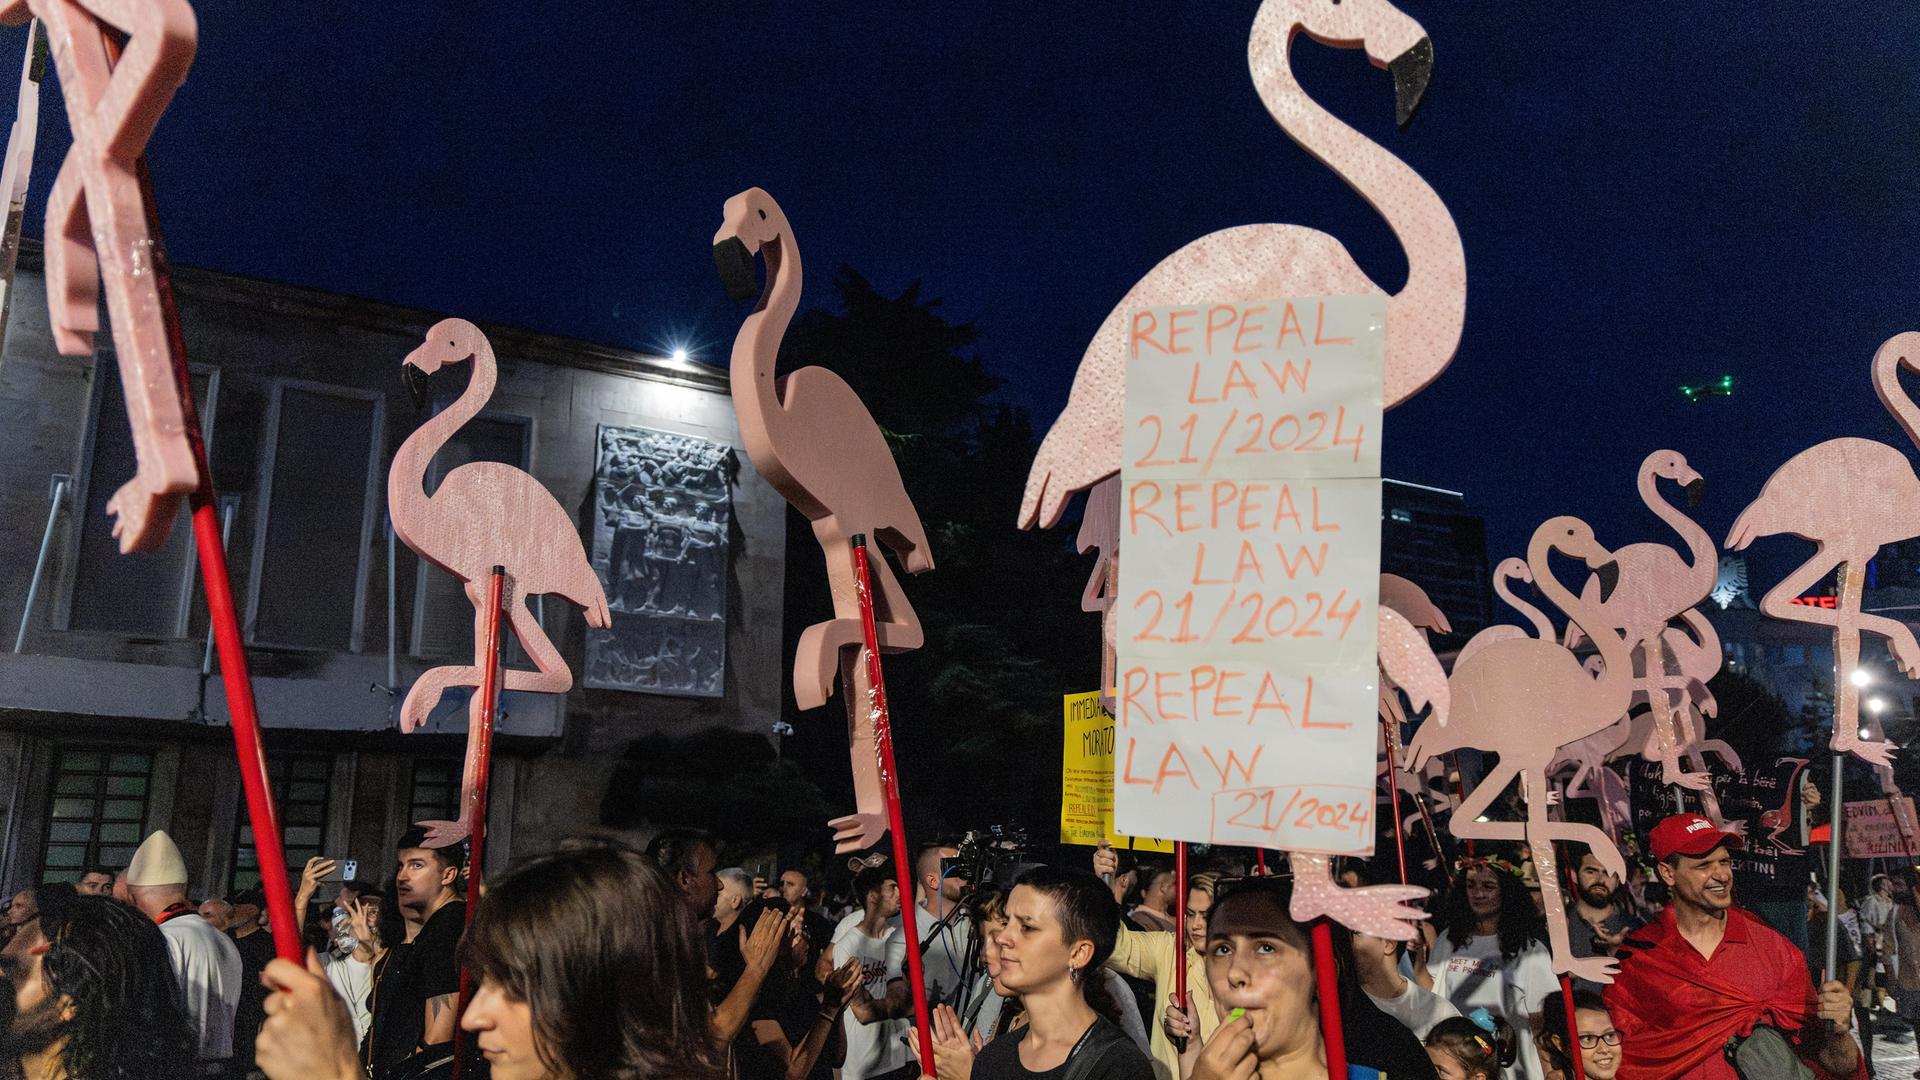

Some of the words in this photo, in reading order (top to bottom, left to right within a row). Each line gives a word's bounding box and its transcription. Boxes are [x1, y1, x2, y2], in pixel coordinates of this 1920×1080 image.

[1130, 302, 1353, 359] REPEAL
[1187, 359, 1312, 405] LAW
[1134, 407, 1365, 474] 21/2024
[1128, 480, 1341, 536] REPEAL
[1191, 540, 1328, 587] LAW
[1133, 588, 1361, 646] 21/2024
[1122, 665, 1352, 730] REPEAL
[1122, 736, 1264, 795] LAW
[1225, 789, 1370, 830] 21/2024
